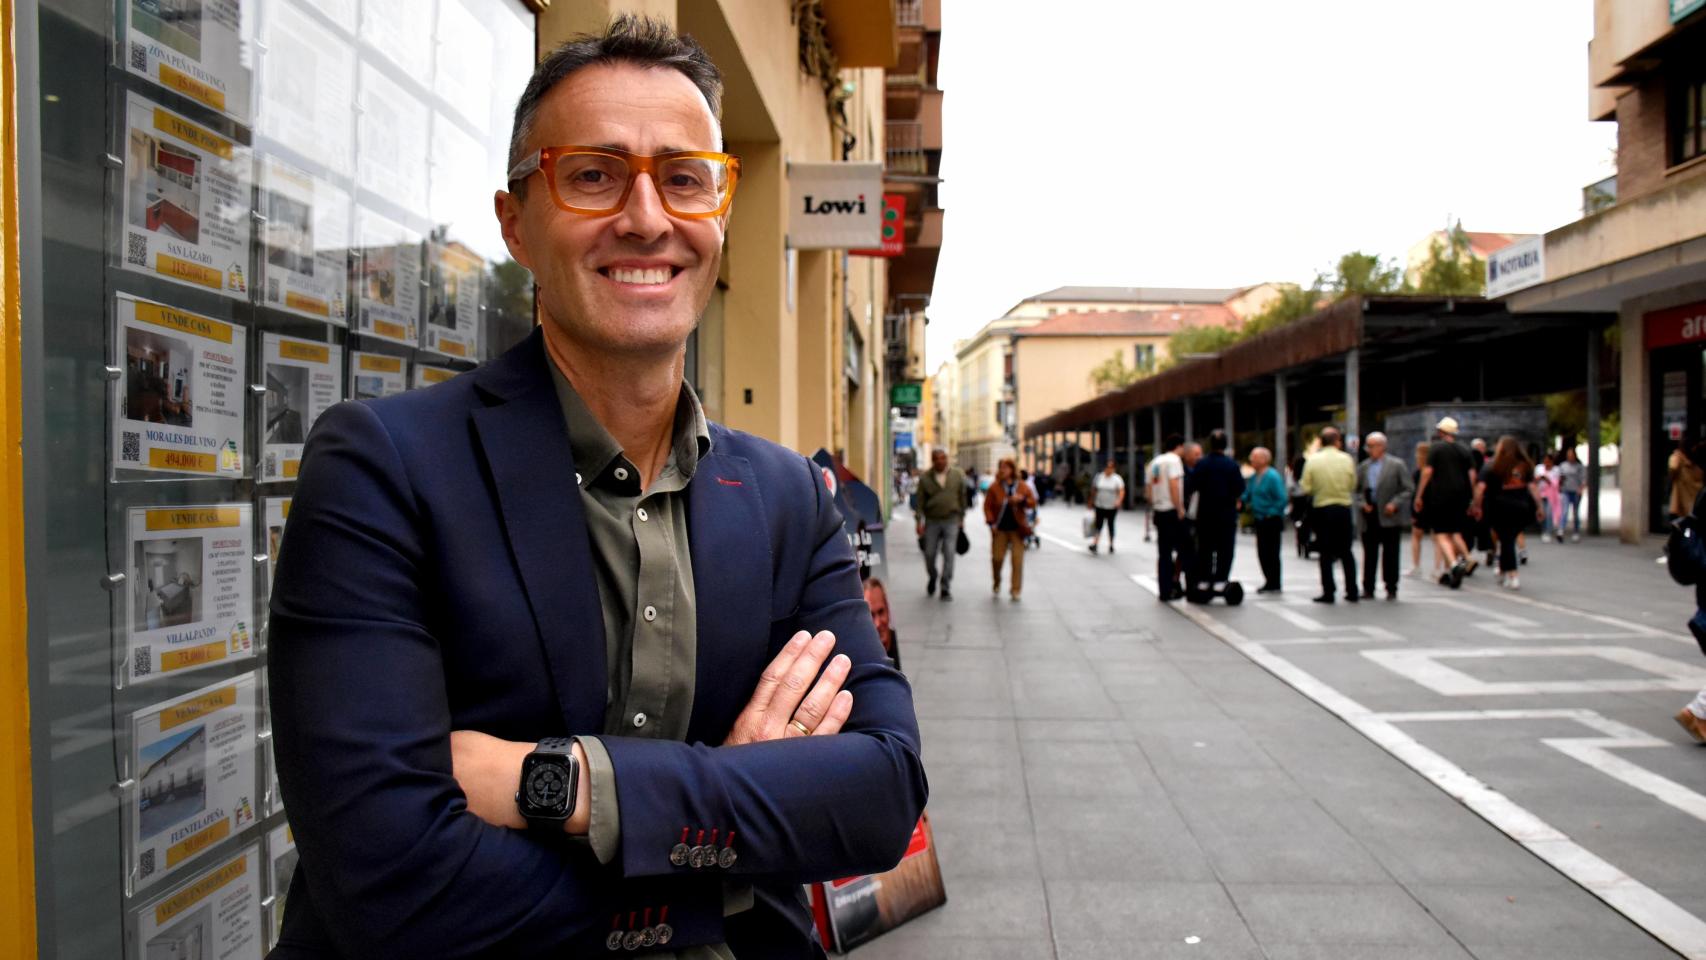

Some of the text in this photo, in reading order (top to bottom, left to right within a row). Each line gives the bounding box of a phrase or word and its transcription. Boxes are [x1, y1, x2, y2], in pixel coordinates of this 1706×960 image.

[803, 194, 867, 215] Lowi
[168, 242, 182, 255] SAN
[160, 310, 212, 335] VENDE CASA
[146, 430, 216, 448] MORALES DEL VINO
[165, 452, 196, 468] 494.000
[170, 511, 219, 524] VENDE CASA
[166, 627, 216, 644] VILLALPANDO
[171, 807, 225, 844] FUENTELAPEÑA
